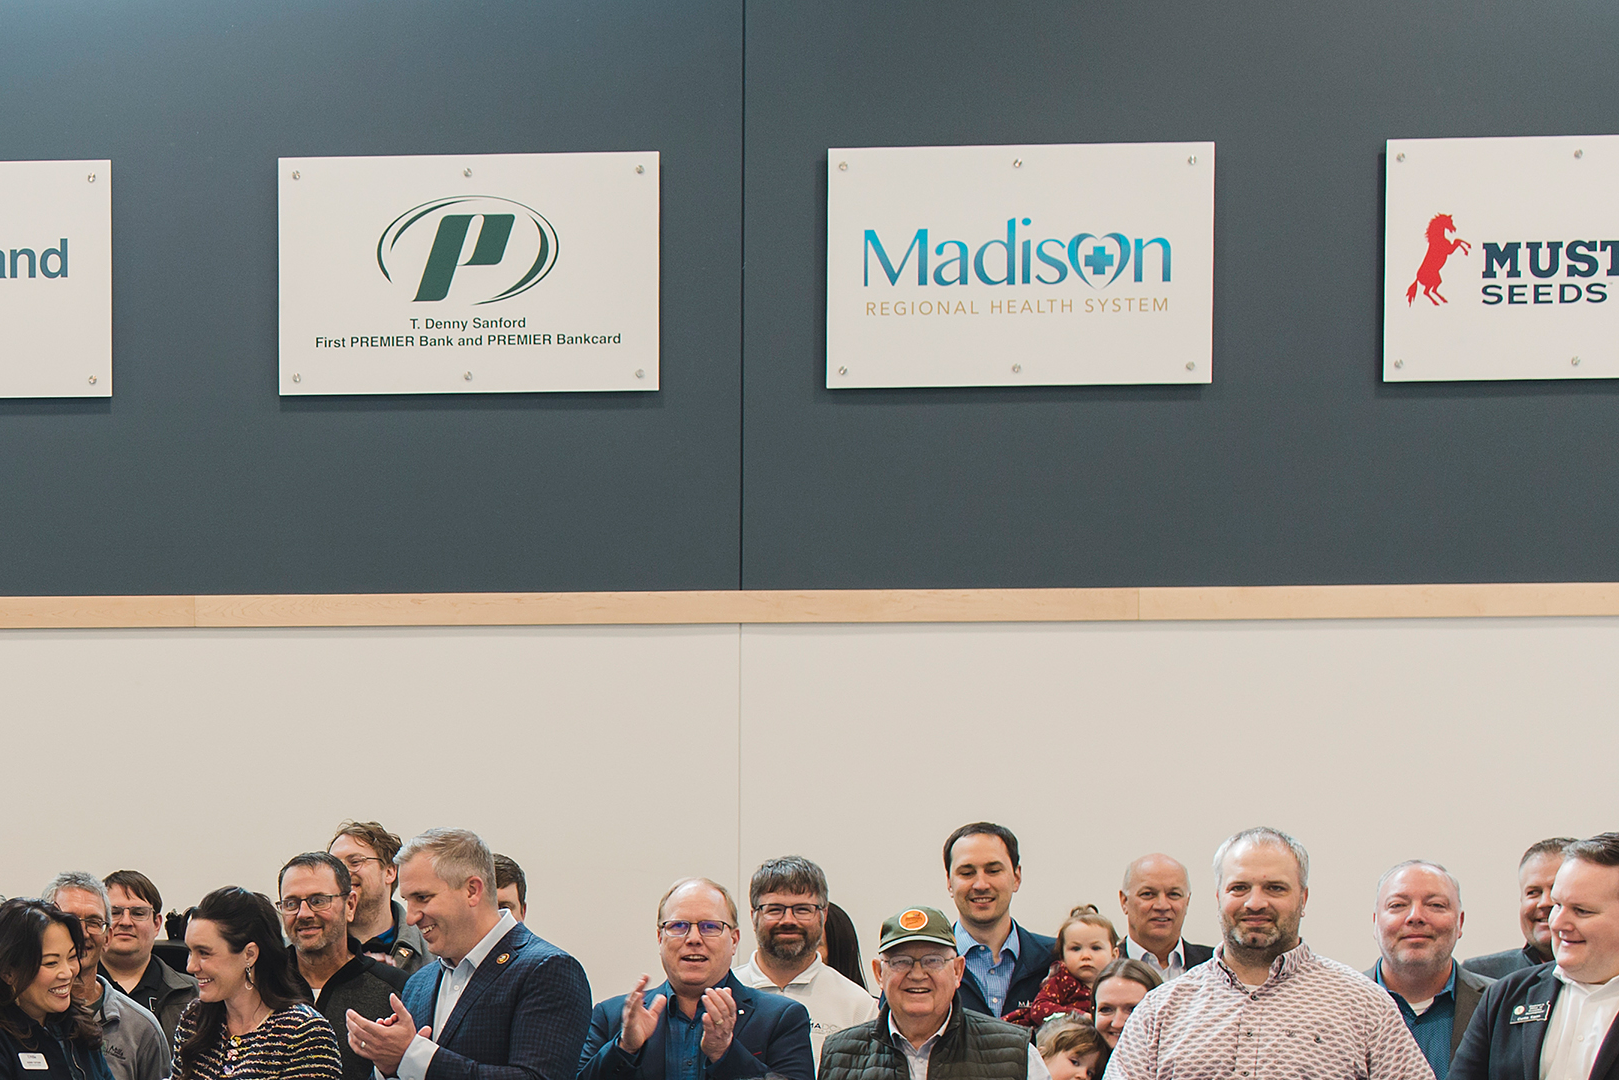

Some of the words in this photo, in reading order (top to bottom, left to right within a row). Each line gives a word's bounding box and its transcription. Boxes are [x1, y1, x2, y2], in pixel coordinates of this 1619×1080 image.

[863, 217, 1172, 291] Madison
[1481, 283, 1608, 305] SEEDS
[866, 300, 979, 316] REGIONAL
[990, 299, 1073, 314] HEALTH
[1085, 298, 1169, 313] SYSTEM
[410, 318, 420, 330] T.
[425, 317, 468, 332] Denny
[472, 317, 527, 329] Sanford
[315, 337, 346, 349] First
[350, 336, 415, 349] PREMIER
[419, 335, 454, 347] Bank
[457, 334, 483, 347] and
[487, 334, 553, 346] PREMIER
[556, 333, 621, 345] Bankcard
